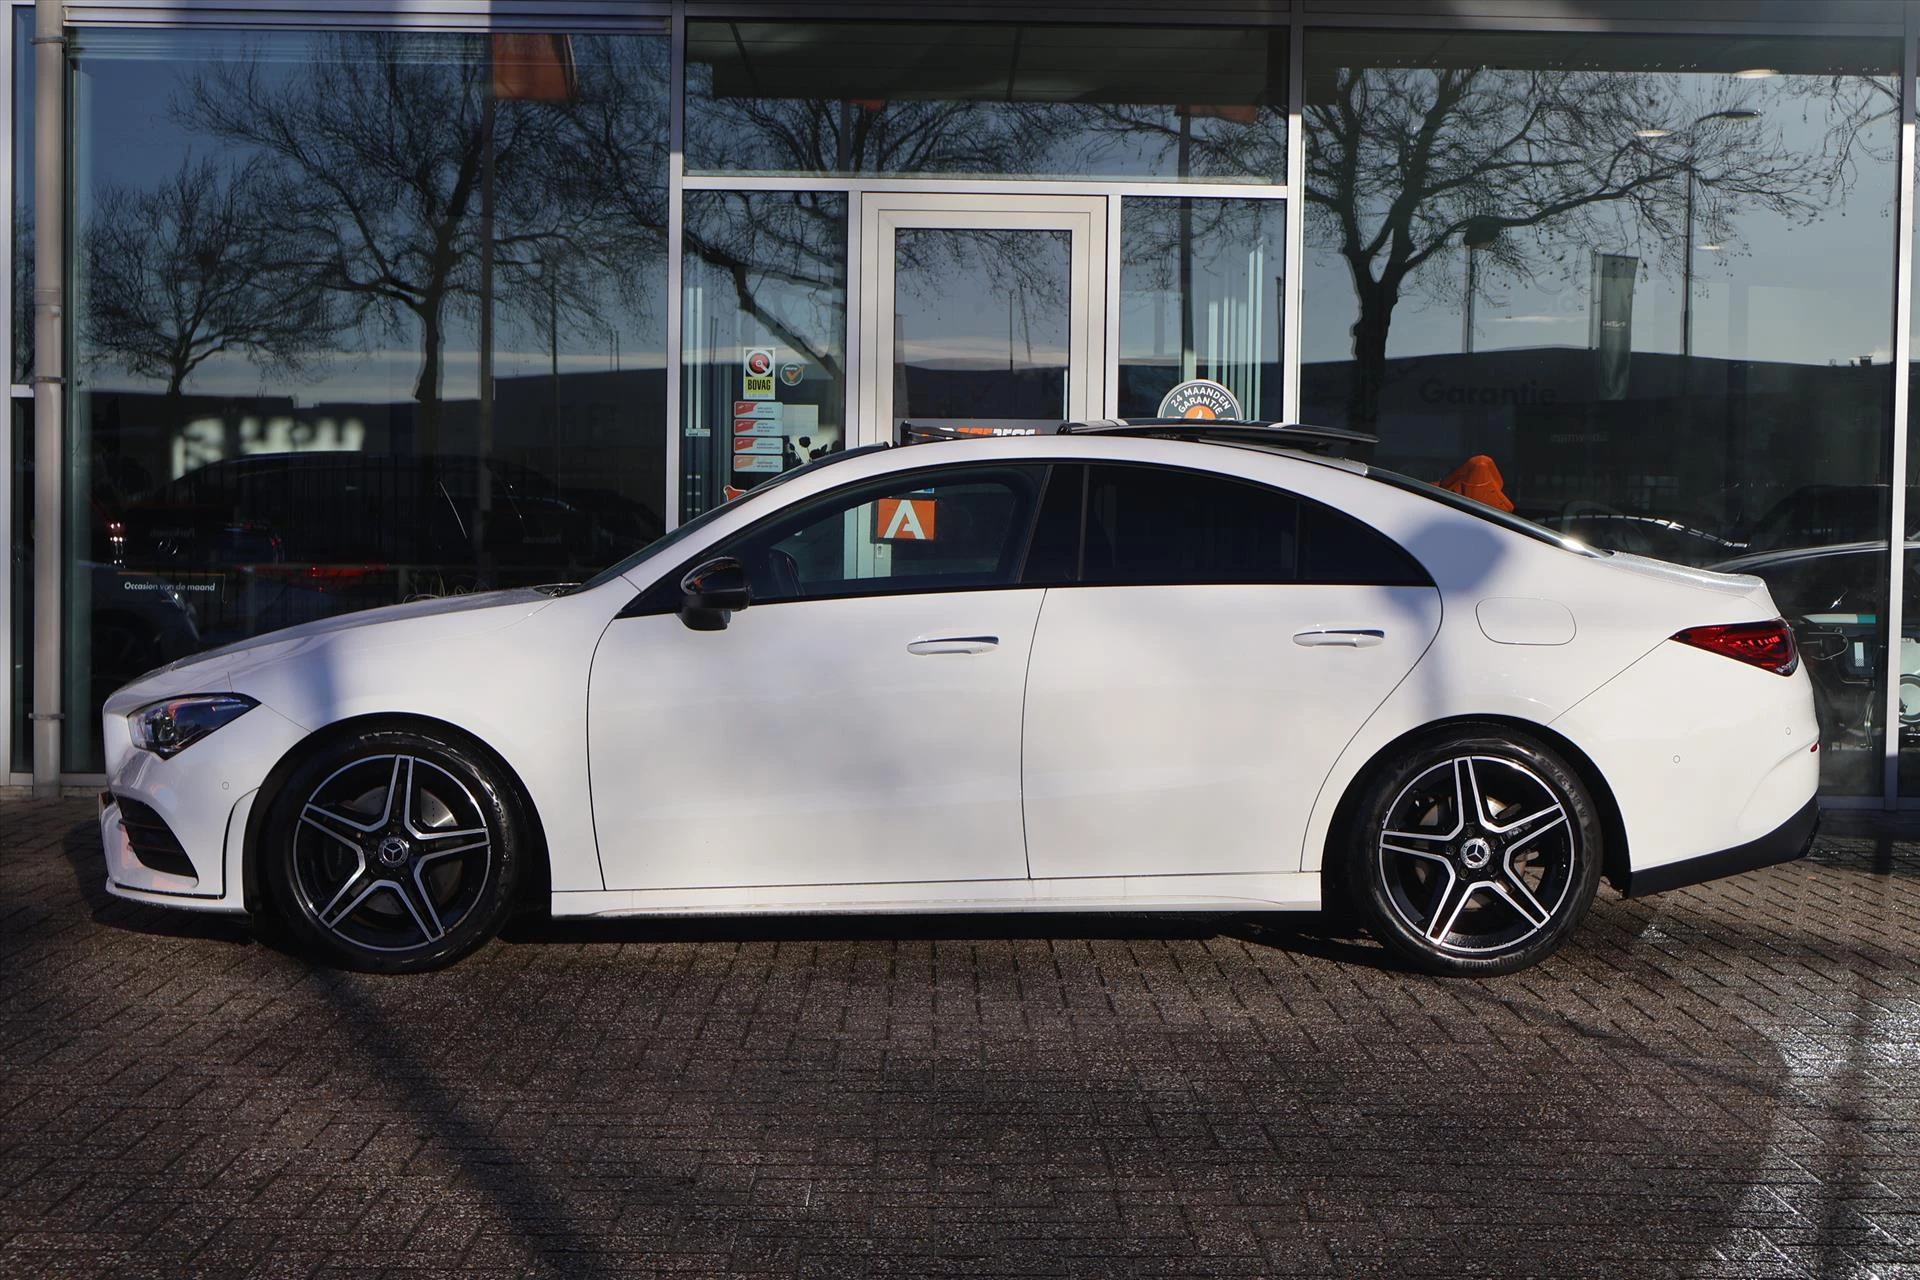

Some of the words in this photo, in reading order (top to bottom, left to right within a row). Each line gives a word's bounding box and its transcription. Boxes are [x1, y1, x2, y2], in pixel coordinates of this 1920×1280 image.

[747, 379, 771, 391] BOVAG
[1418, 377, 1557, 406] Garantie
[1171, 395, 1183, 407] 24
[1184, 387, 1231, 409] MAANDEN
[1178, 397, 1223, 414] GARANTIE
[124, 581, 158, 590] Occasion
[175, 582, 186, 591] de
[187, 582, 216, 591] maand
